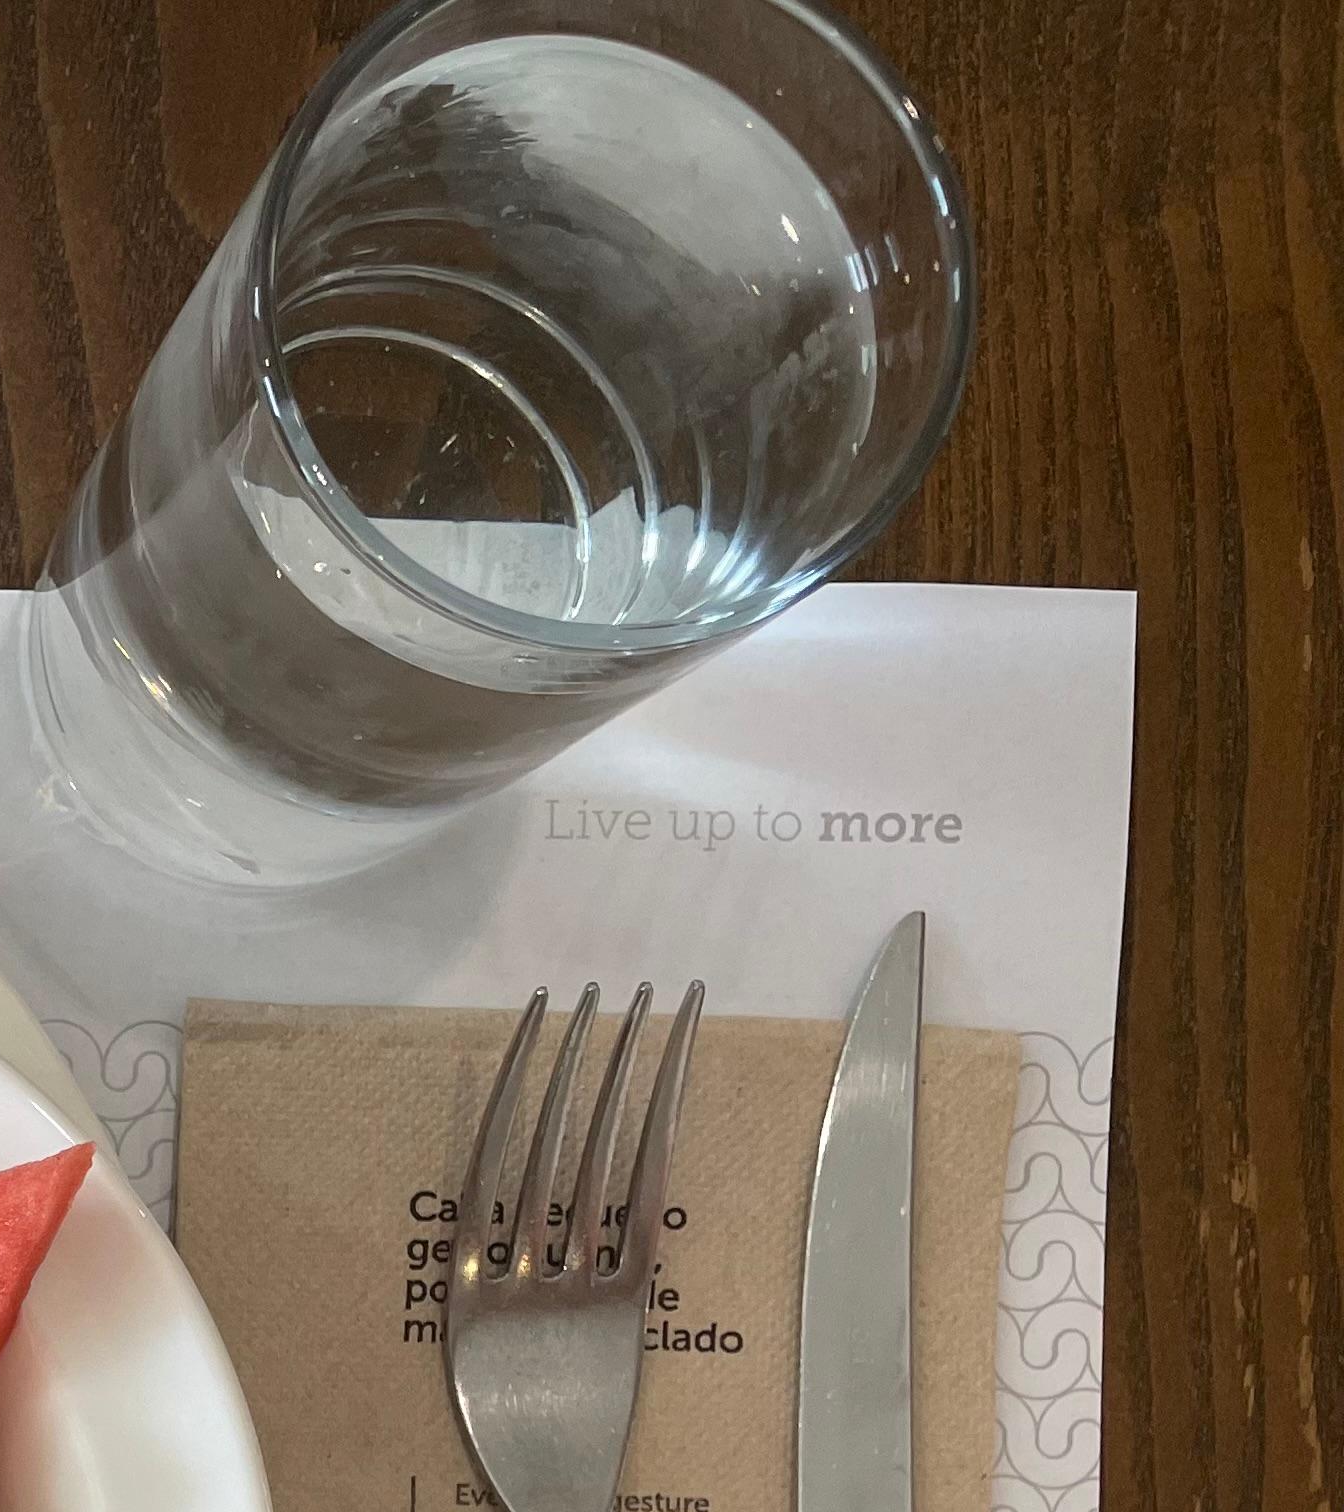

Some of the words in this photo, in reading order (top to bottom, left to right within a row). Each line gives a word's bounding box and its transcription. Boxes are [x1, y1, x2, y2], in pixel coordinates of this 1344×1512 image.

[545, 800, 651, 840] Live
[669, 811, 735, 852] up
[755, 805, 801, 842] to
[819, 813, 962, 843] more
[410, 1191, 504, 1225] Caa
[407, 1239, 508, 1270] geo
[405, 1279, 449, 1310] po
[644, 1320, 743, 1353] clado
[456, 1483, 498, 1506] Eve
